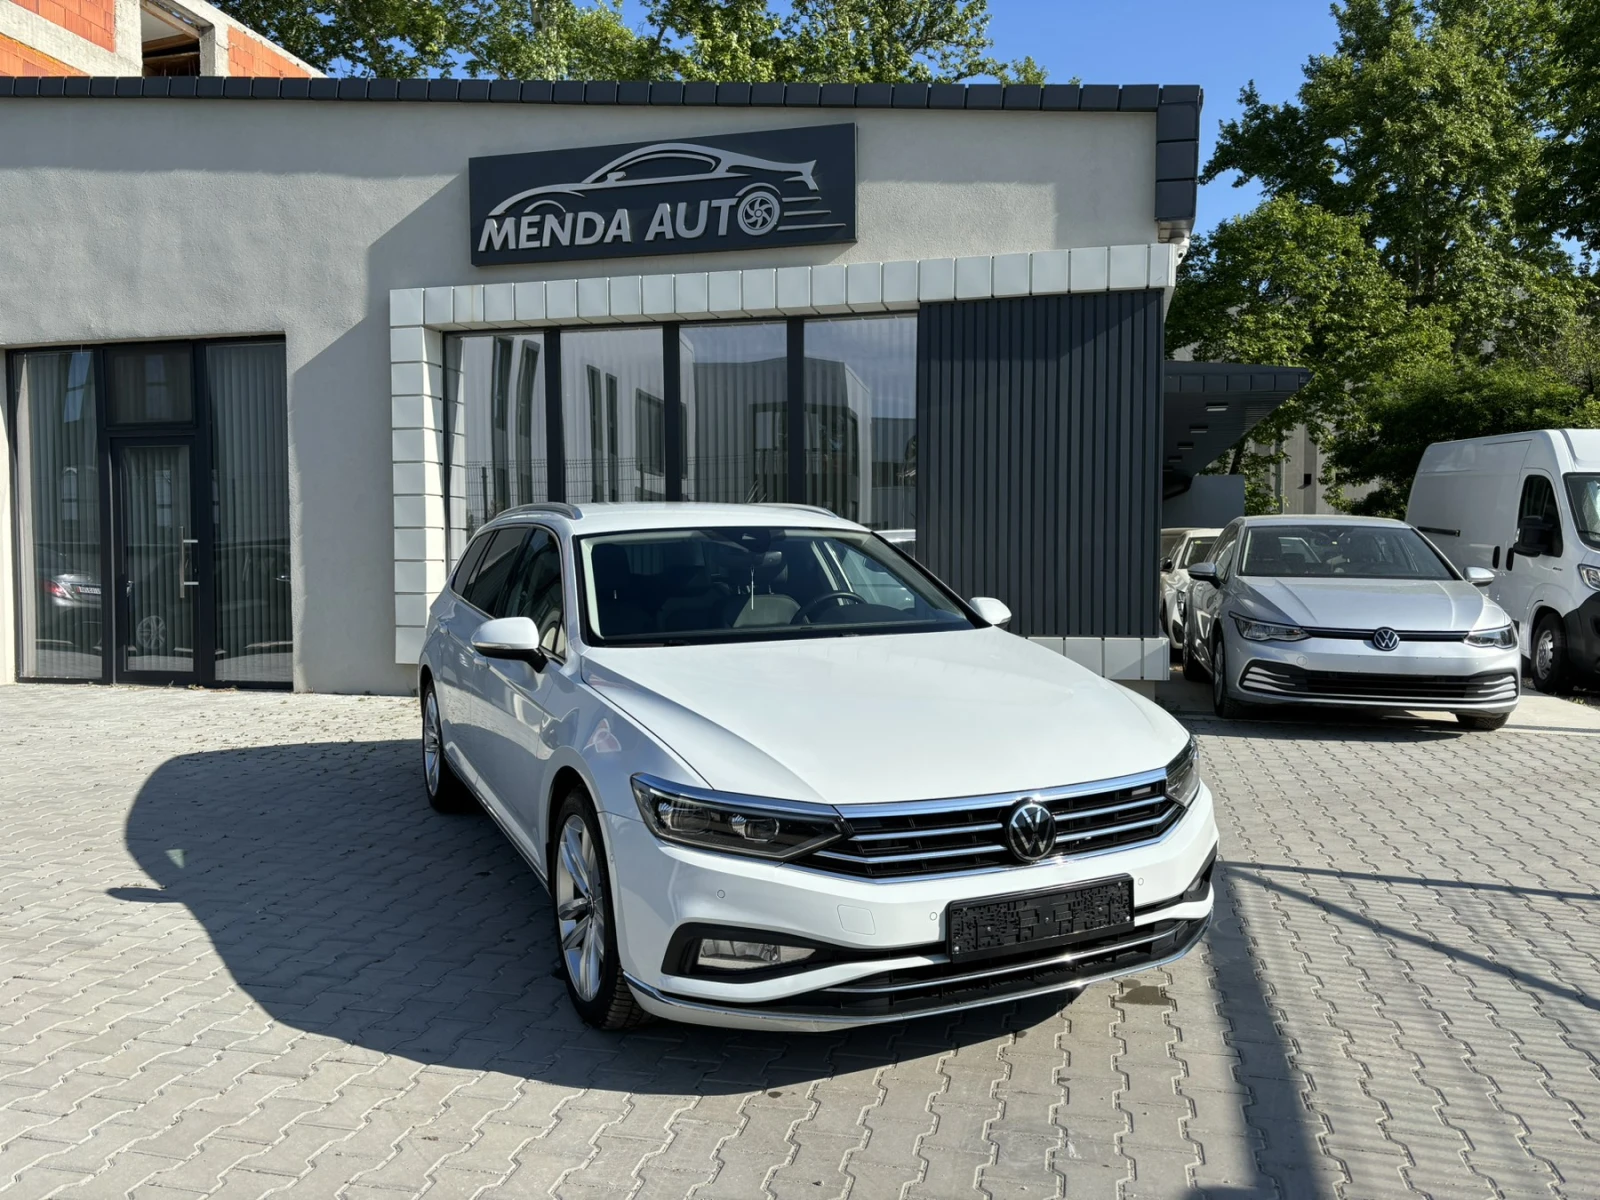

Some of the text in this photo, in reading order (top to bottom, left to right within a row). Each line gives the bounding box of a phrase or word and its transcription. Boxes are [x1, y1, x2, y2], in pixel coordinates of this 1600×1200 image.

[478, 191, 781, 252] MENDA AUTO
[1374, 628, 1400, 650] VW
[1009, 803, 1055, 859] VW
